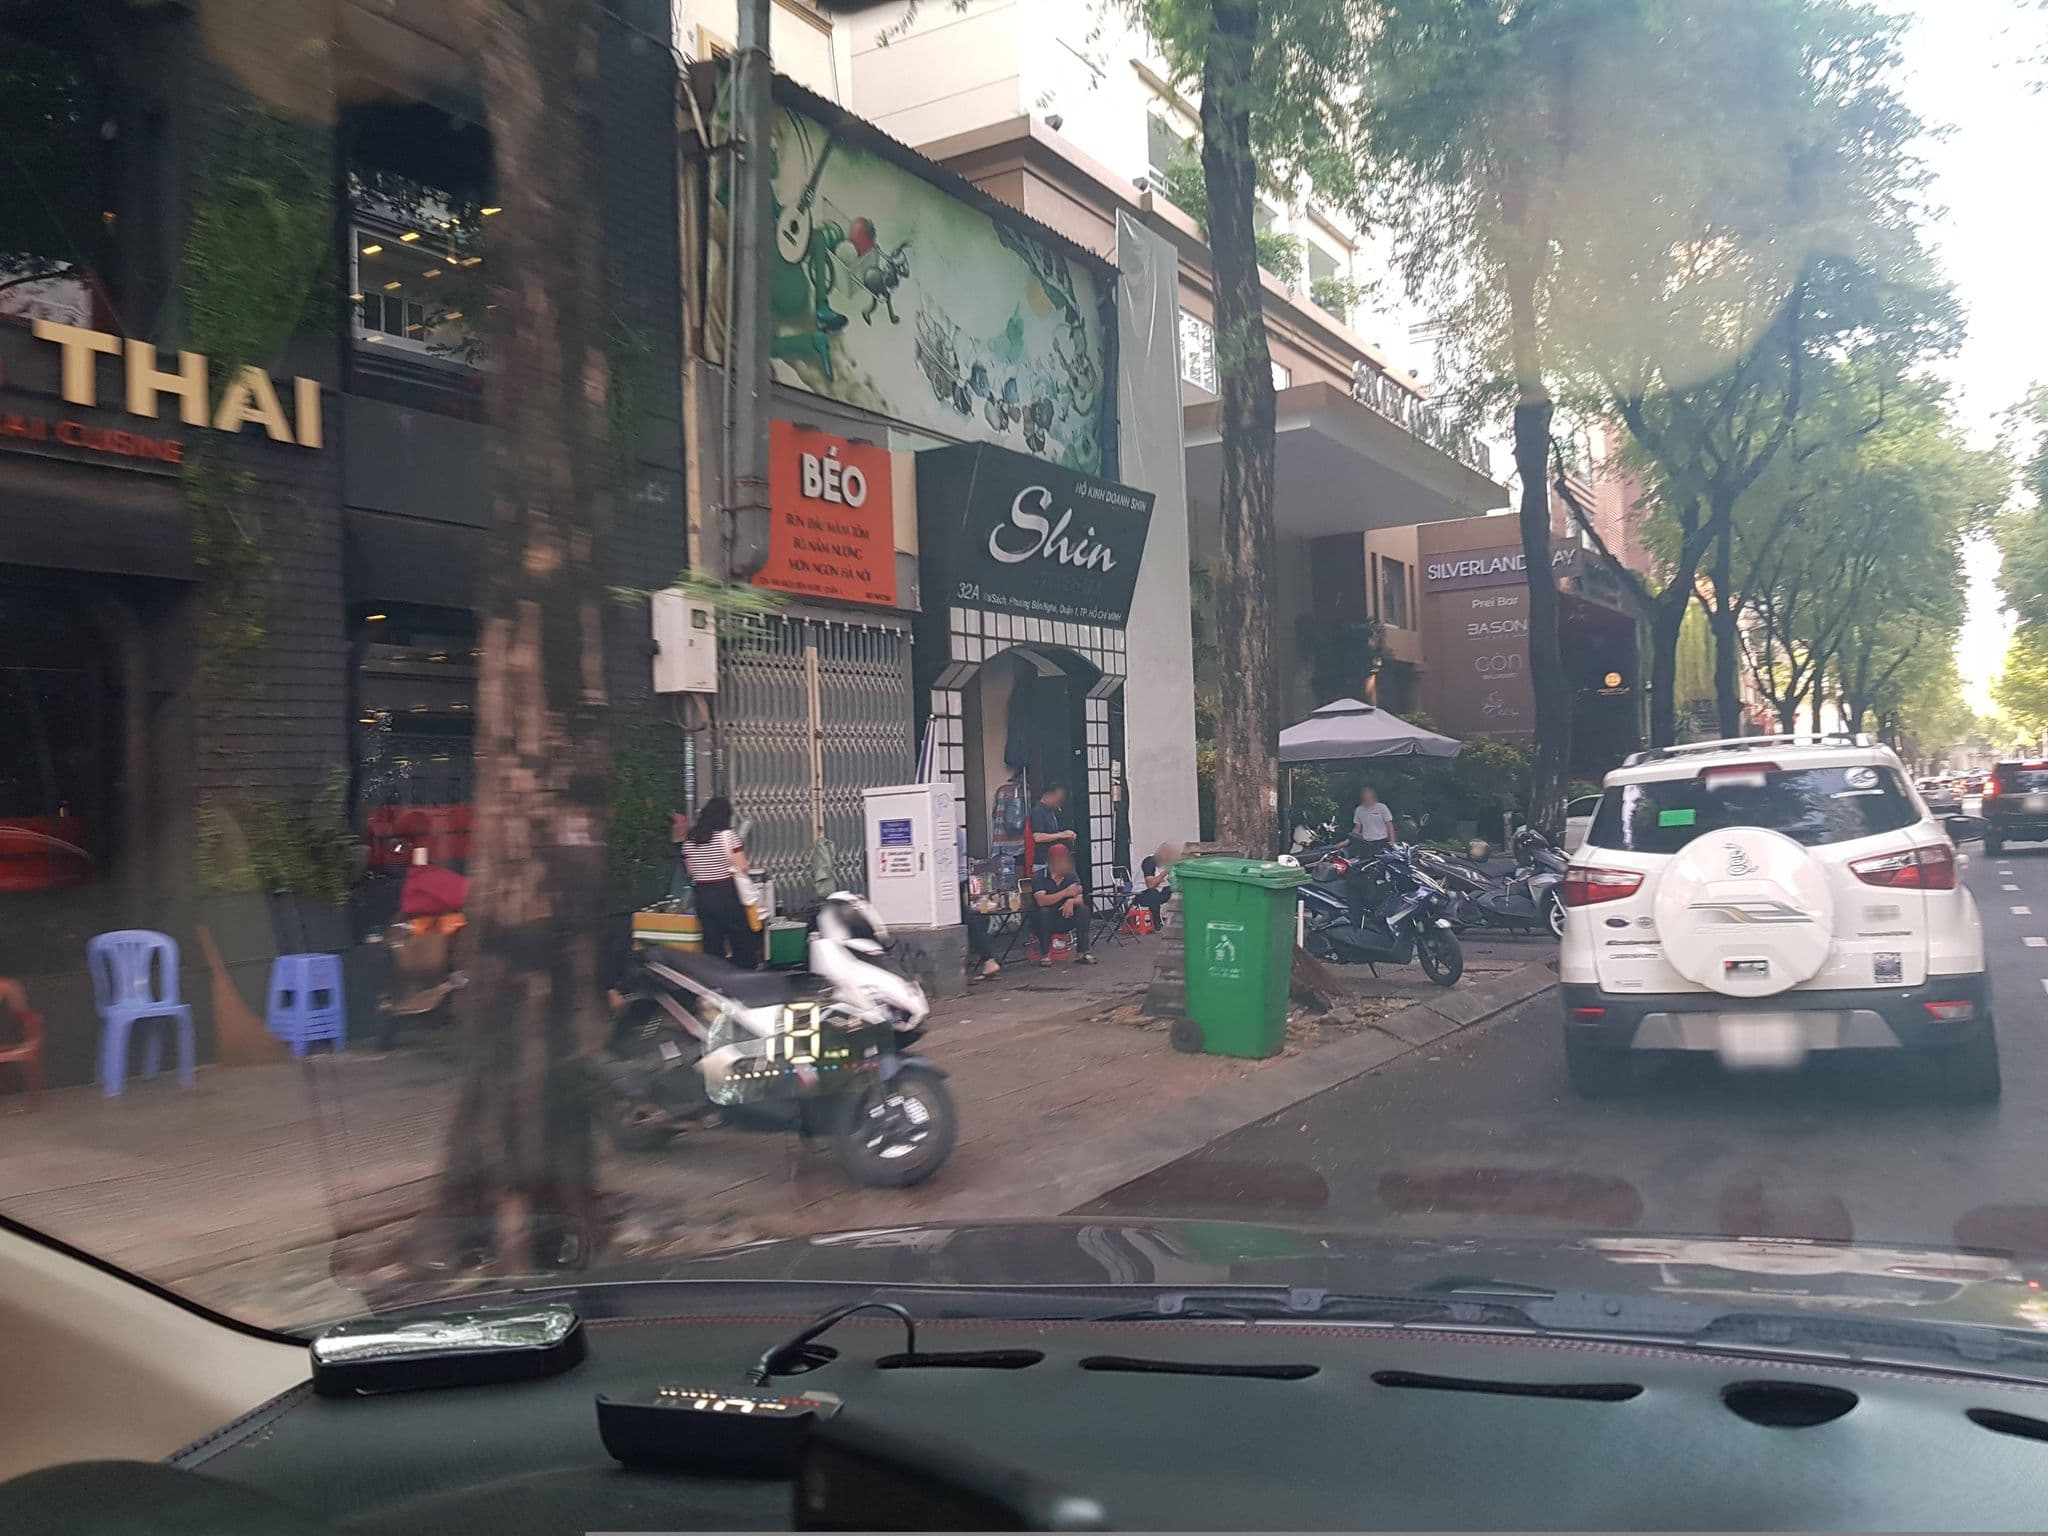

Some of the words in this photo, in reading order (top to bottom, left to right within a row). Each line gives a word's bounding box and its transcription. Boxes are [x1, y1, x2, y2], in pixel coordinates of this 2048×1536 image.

[32, 318, 323, 449] THAI
[1087, 486, 1106, 501] KINH
[1105, 490, 1130, 508] DOANH
[1130, 498, 1147, 513] SHIN
[989, 485, 1117, 573] Shin
[957, 582, 980, 600] 32A
[1497, 596, 1520, 607] Bar
